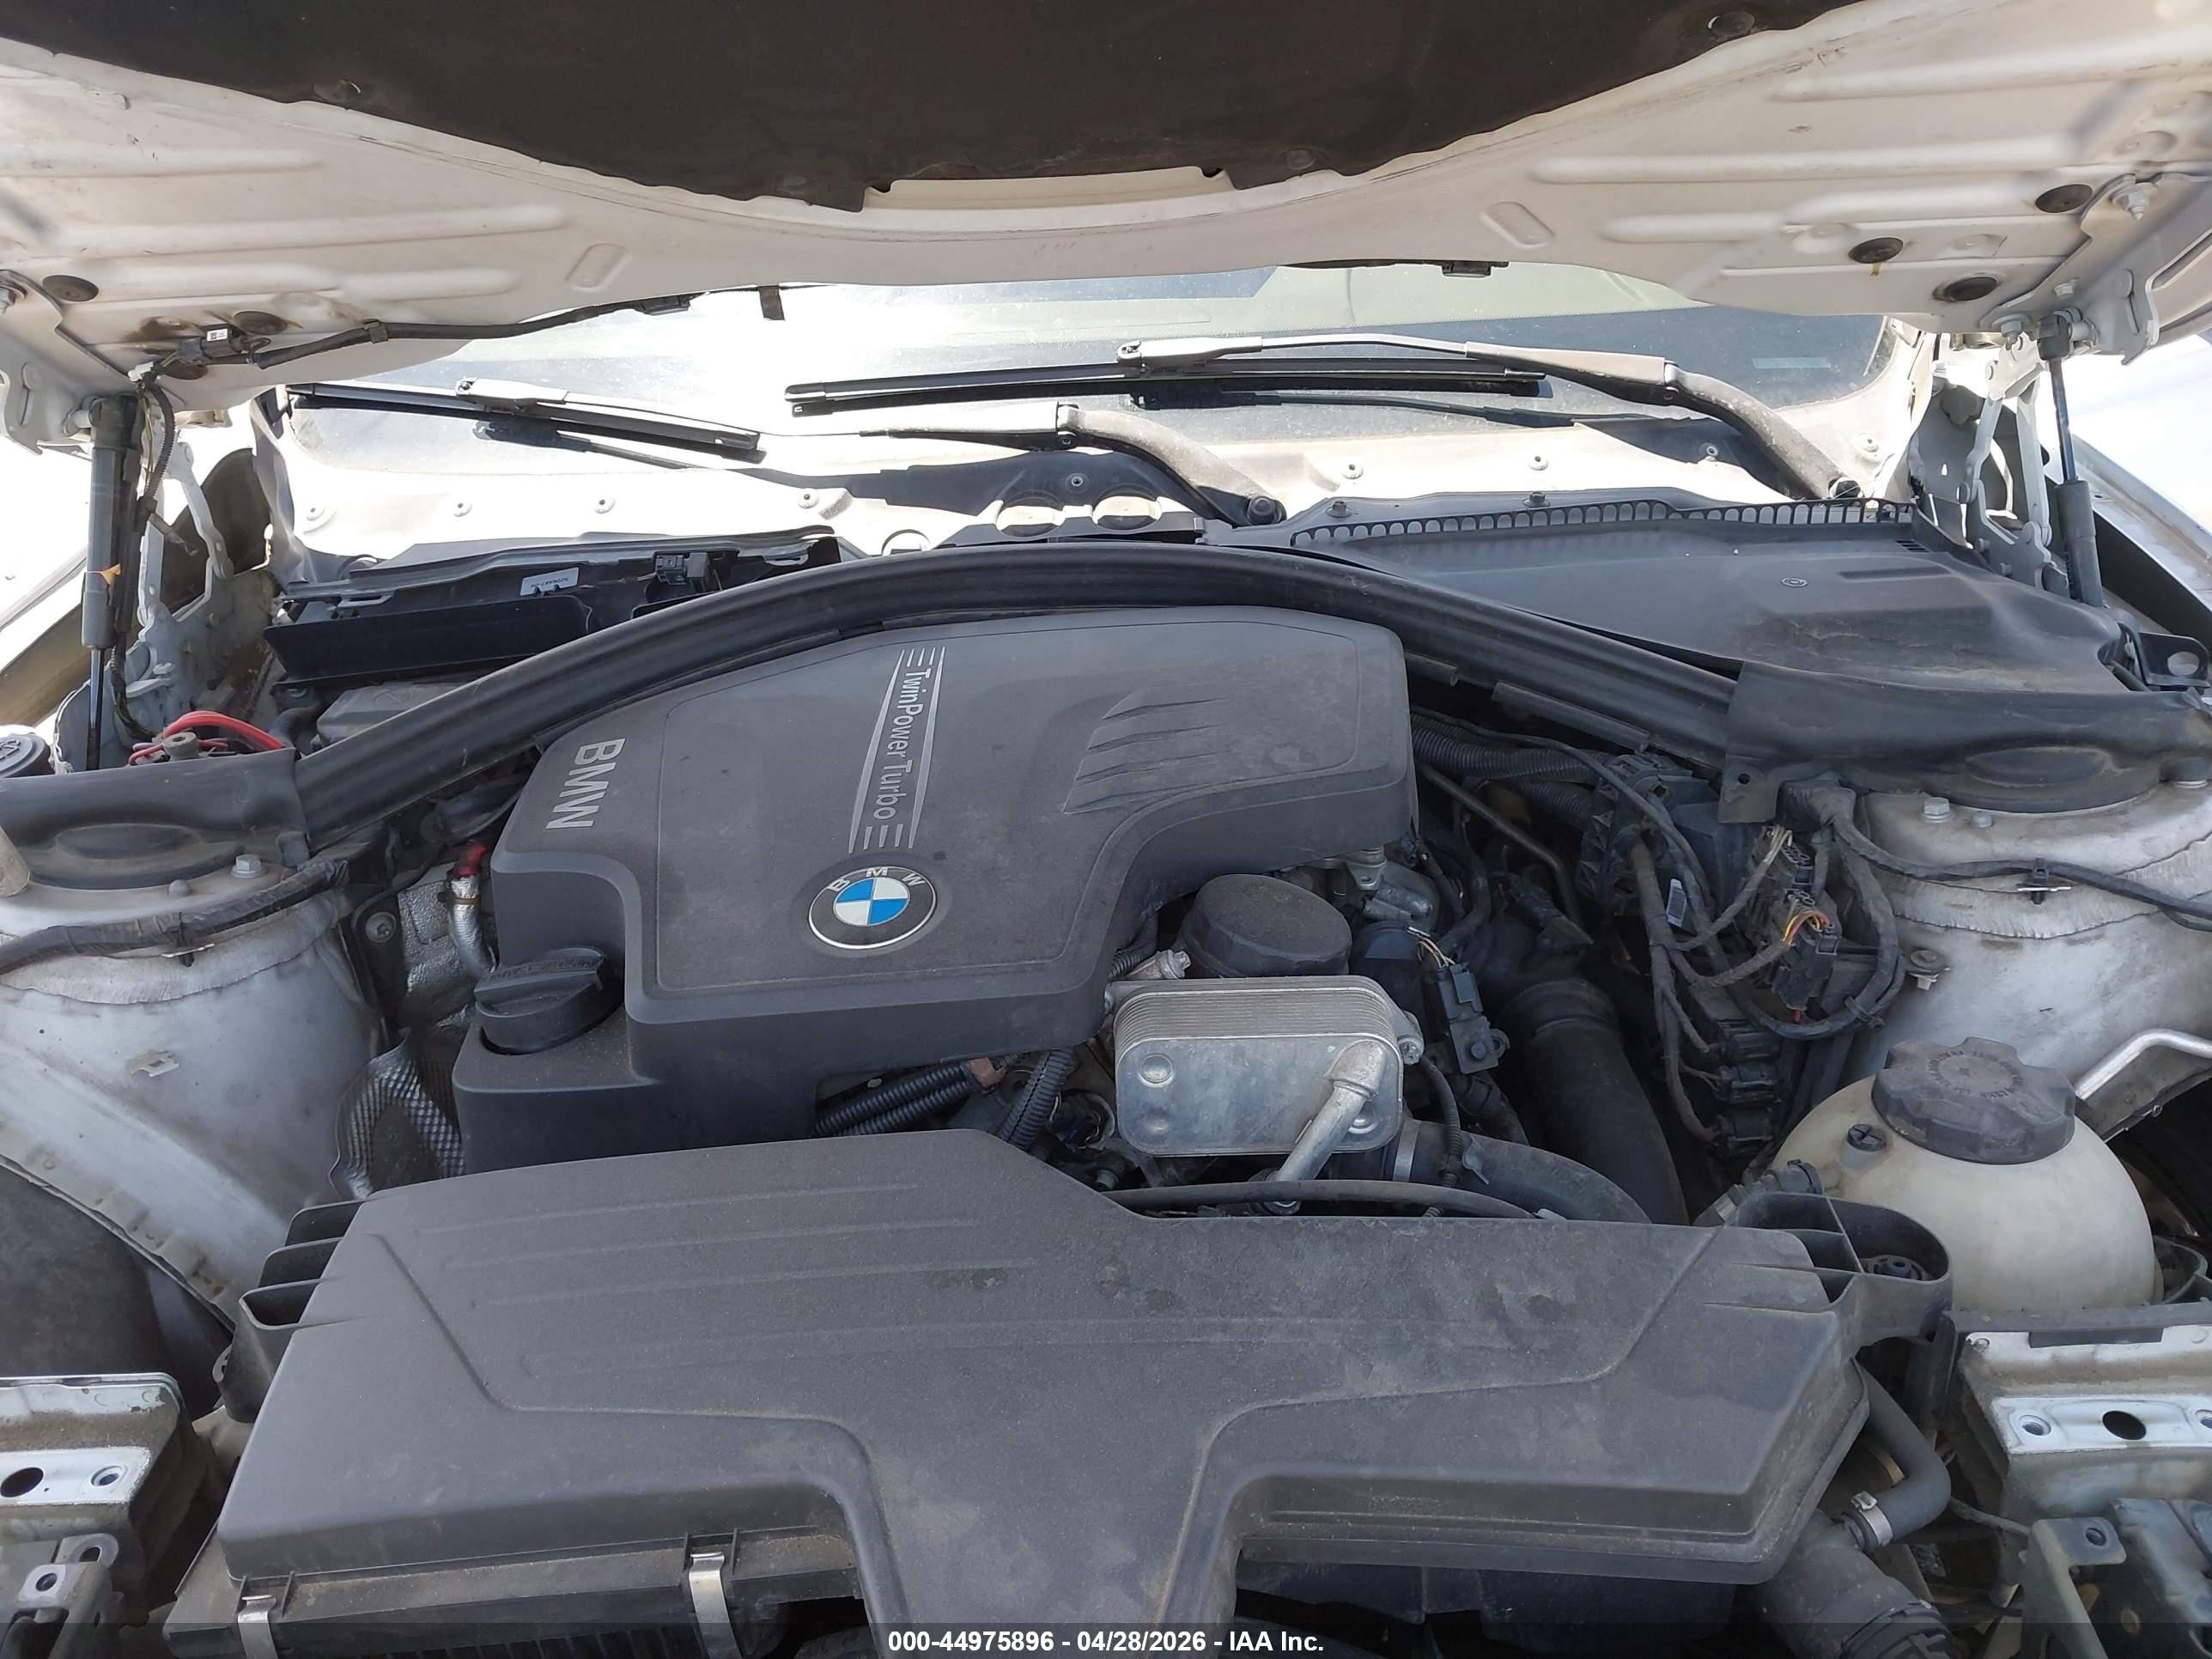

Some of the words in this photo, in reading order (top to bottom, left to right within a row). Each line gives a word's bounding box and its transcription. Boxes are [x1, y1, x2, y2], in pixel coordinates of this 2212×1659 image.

[886, 667, 932, 757] TwinPower
[545, 738, 626, 830] BMW
[873, 759, 913, 820] Turbo
[827, 867, 926, 892] BMW
